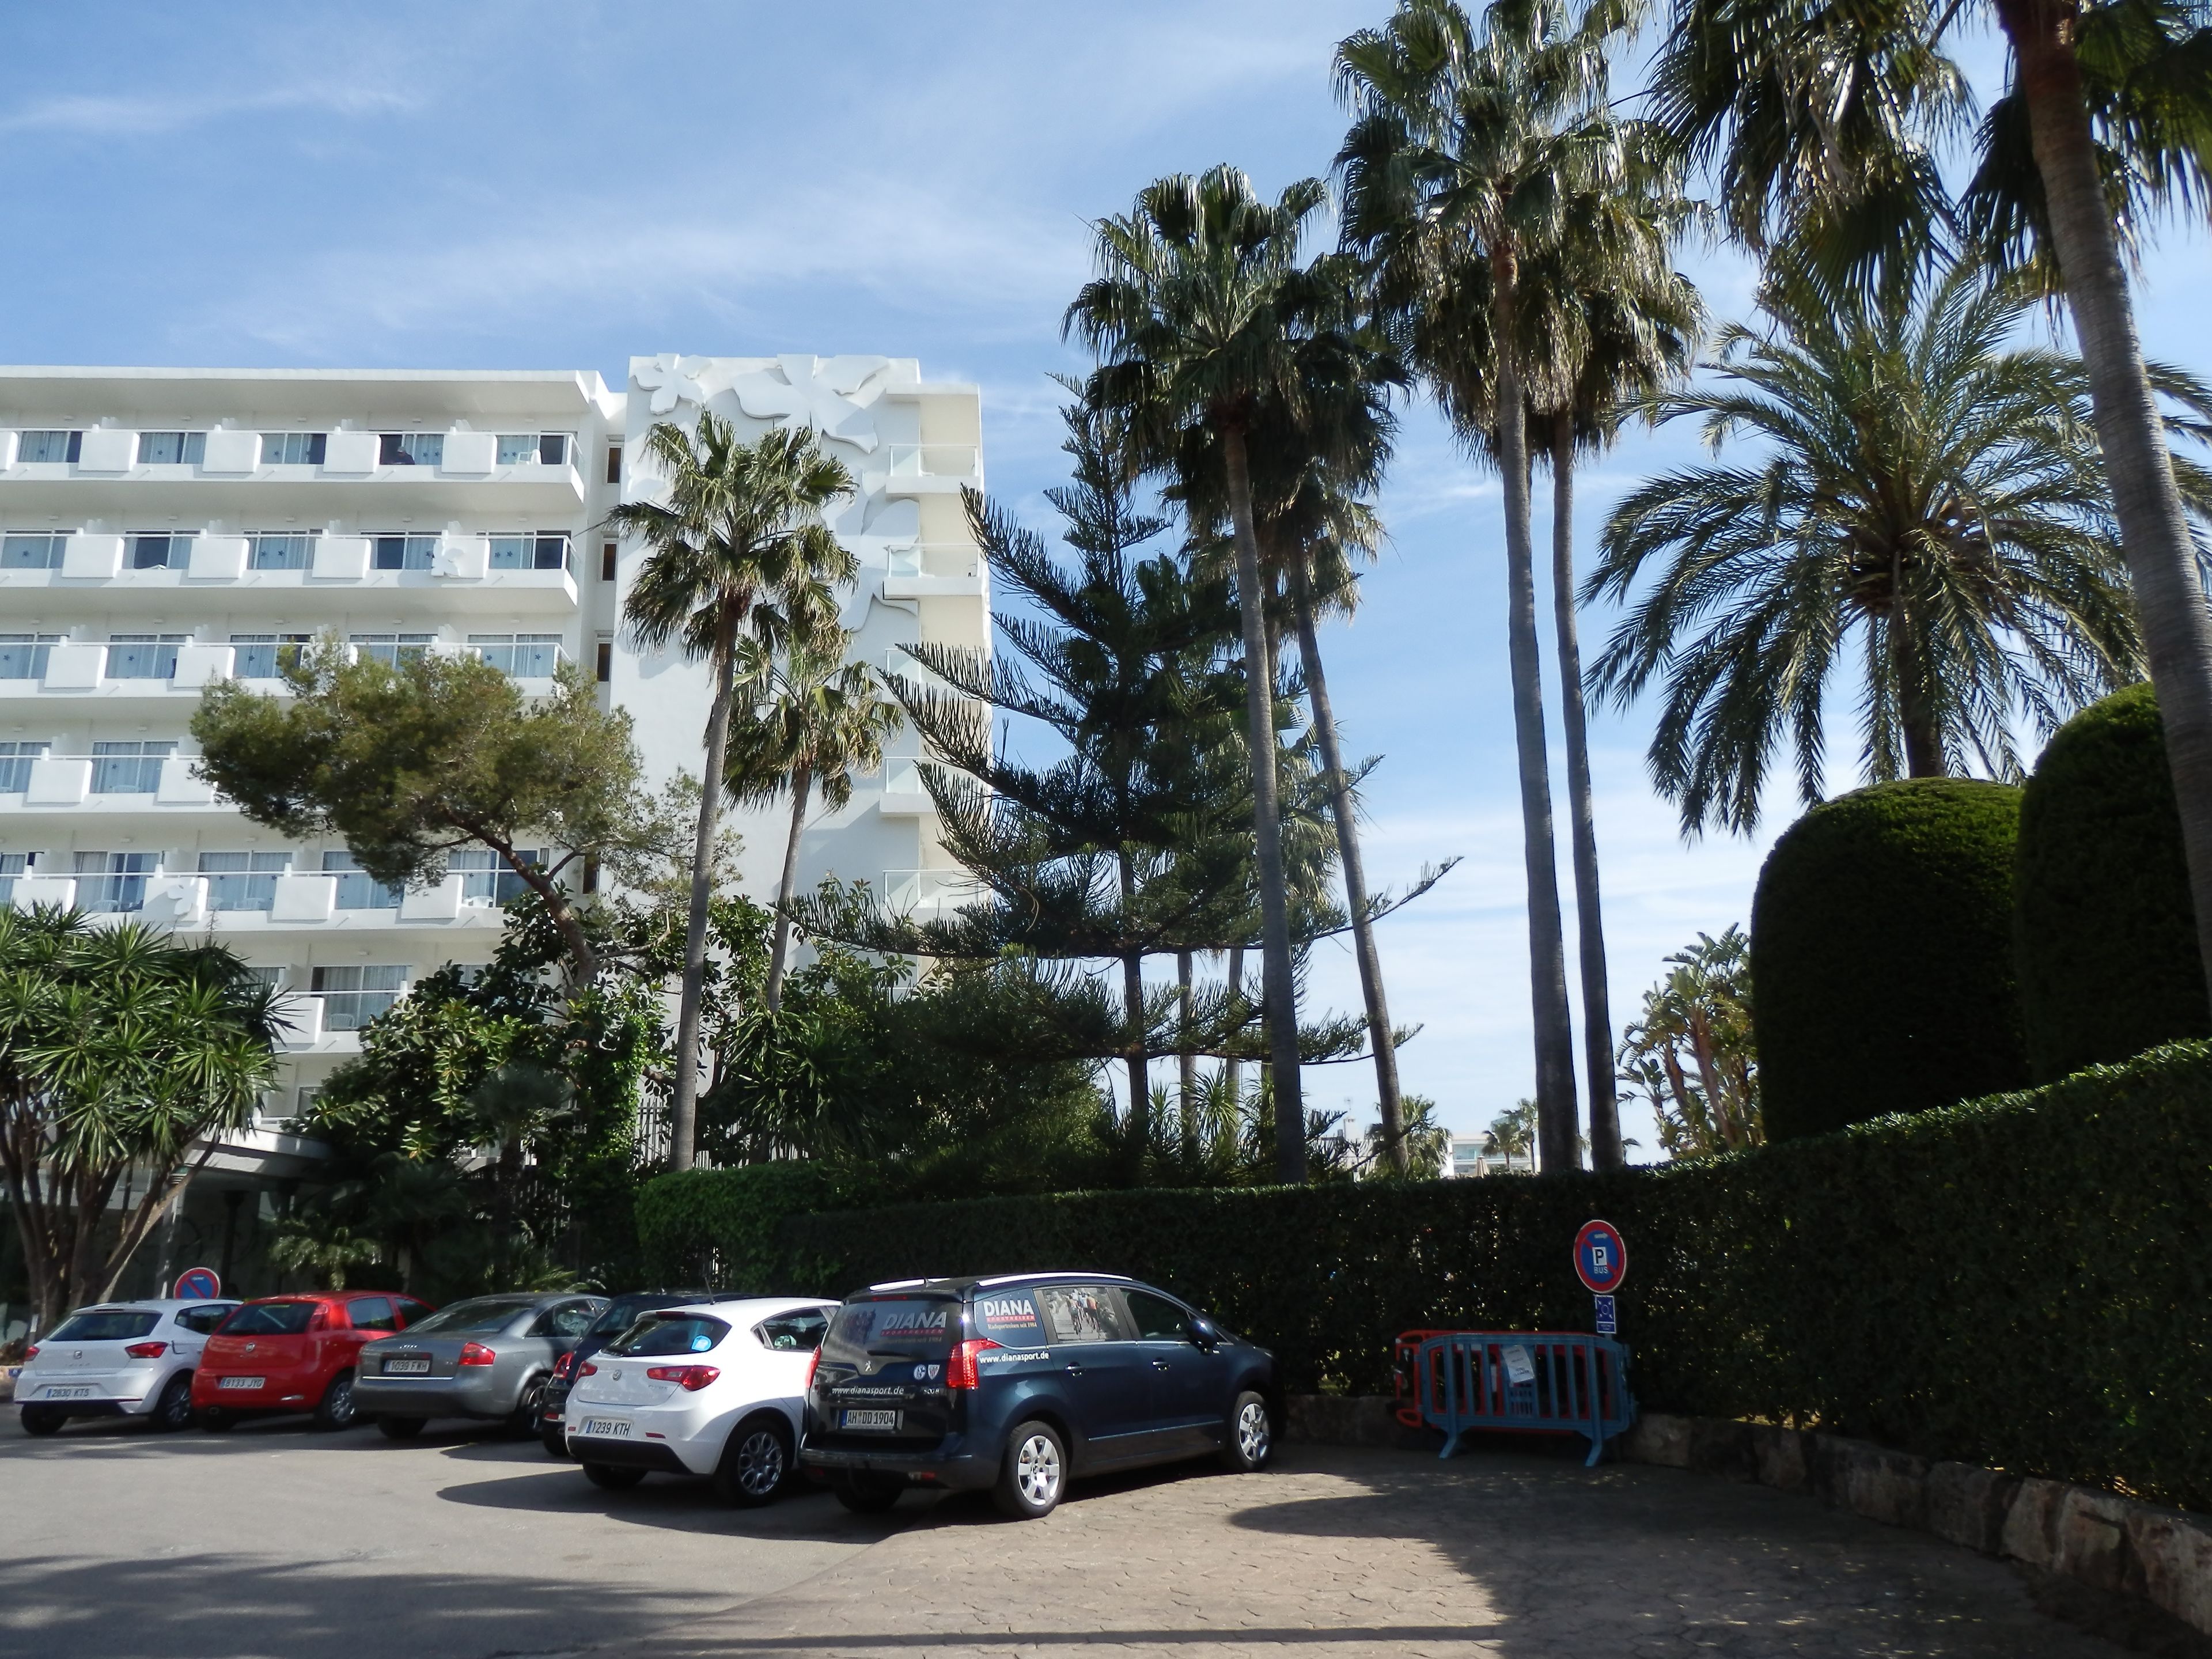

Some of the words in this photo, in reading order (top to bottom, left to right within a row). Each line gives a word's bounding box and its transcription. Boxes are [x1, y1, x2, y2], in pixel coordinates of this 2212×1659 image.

[1595, 1249, 1604, 1264] P
[983, 1300, 1035, 1316] DIANA
[882, 1312, 947, 1329] DIANA
[979, 1351, 1049, 1363] www.dianasport.de
[832, 1386, 904, 1396] www.dianasport.de
[847, 1411, 857, 1424] AH
[862, 1412, 873, 1425] DD
[874, 1412, 894, 1424] 1904
[592, 1421, 612, 1434] 1239
[613, 1423, 631, 1437] KTH
